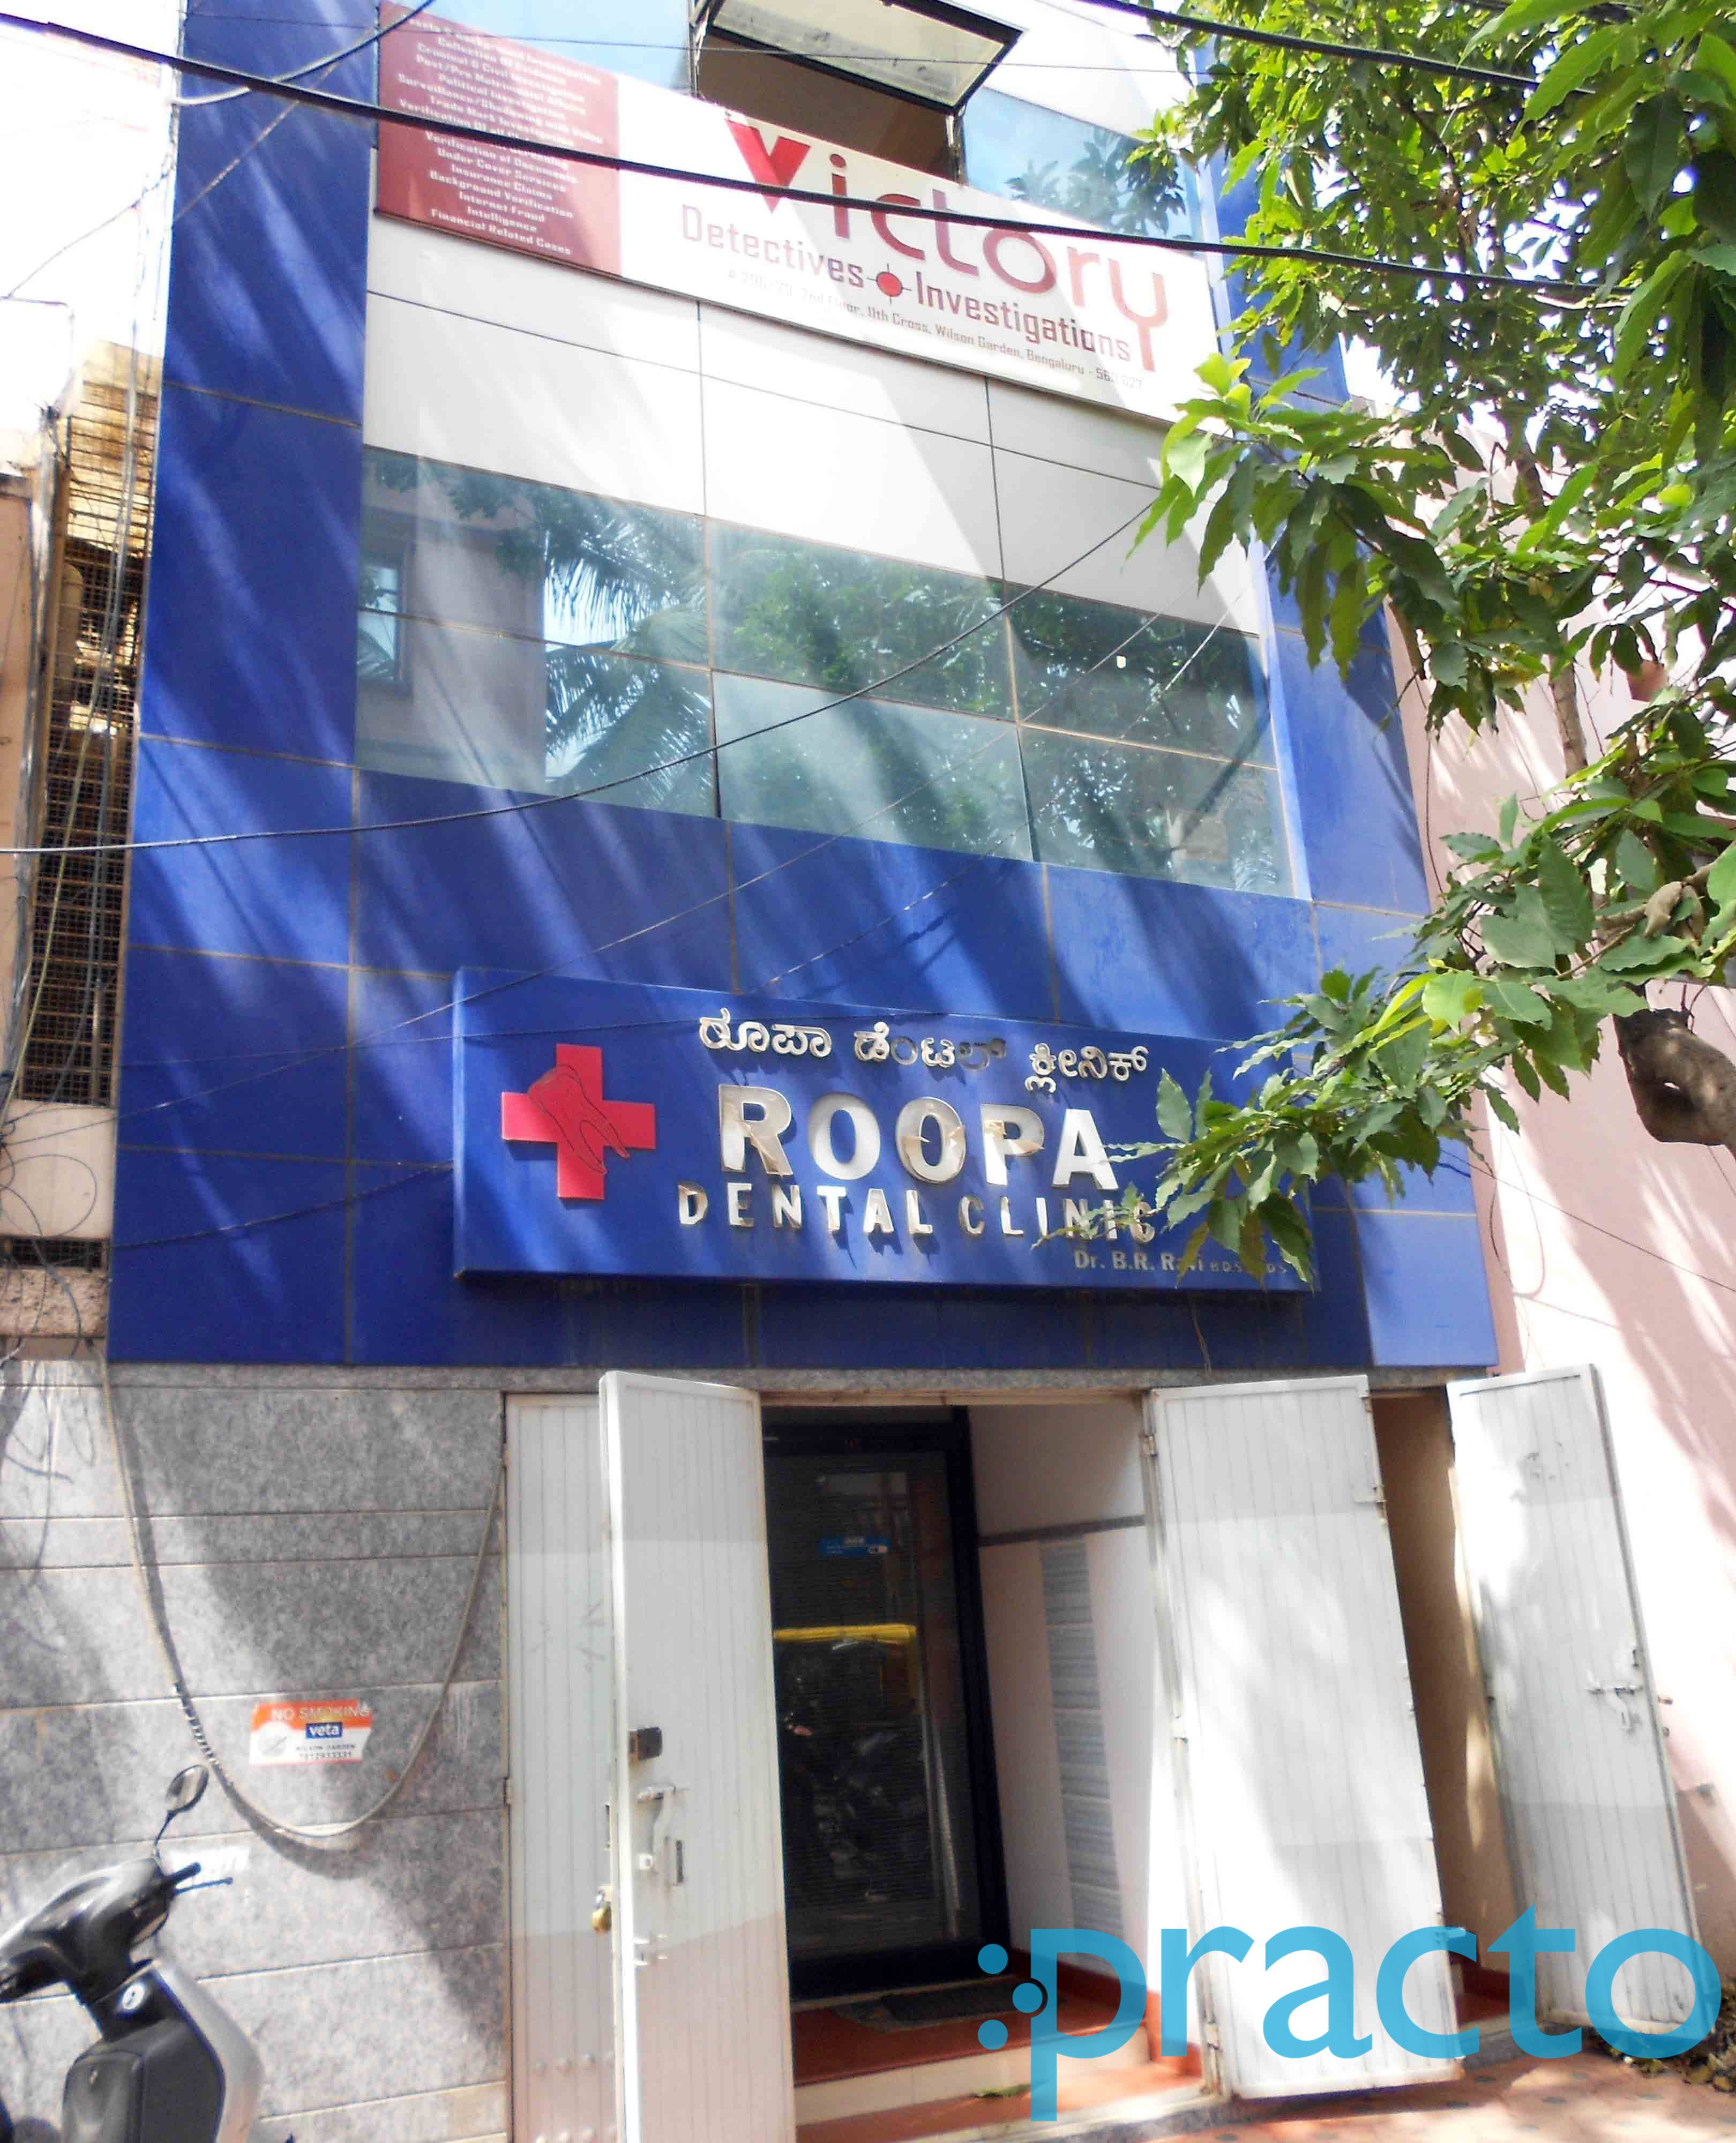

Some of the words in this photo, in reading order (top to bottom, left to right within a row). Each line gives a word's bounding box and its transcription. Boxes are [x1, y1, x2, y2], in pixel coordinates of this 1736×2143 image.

[417, 42, 468, 66] Criminal
[482, 63, 507, 78] Civil
[438, 73, 487, 96] Political
[430, 95, 463, 114] Trade
[467, 107, 495, 123] Mark
[425, 131, 496, 160] Verification
[514, 158, 577, 184] Documents
[437, 147, 473, 166] Under
[477, 159, 511, 177] Cover
[514, 170, 566, 193] Services
[430, 169, 500, 199] Background
[504, 191, 573, 219] Verification
[451, 163, 511, 189] Insurance
[514, 182, 552, 201] Claims
[459, 191, 508, 213] Internet
[512, 206, 544, 223] Fraud
[467, 206, 536, 232] Intelligence
[431, 209, 485, 231] Financial
[488, 224, 534, 245] Related
[536, 237, 571, 255] Cases
[682, 204, 864, 288] Detectives
[916, 271, 1132, 362] Investigations
[893, 312, 932, 335] Cross,
[935, 324, 975, 345] Wilson
[978, 335, 1021, 358] Garden,
[1027, 348, 1084, 376] Bengaluru
[717, 1083, 1119, 1191] ROOPA
[677, 1181, 933, 1236] DENTAL
[958, 1195, 1156, 1243] CLINIC
[1074, 1250, 1106, 1270] Dr.
[1111, 1251, 1155, 1271] B.R.
[271, 1708, 295, 1721] NO
[308, 1724, 339, 1736] veta
